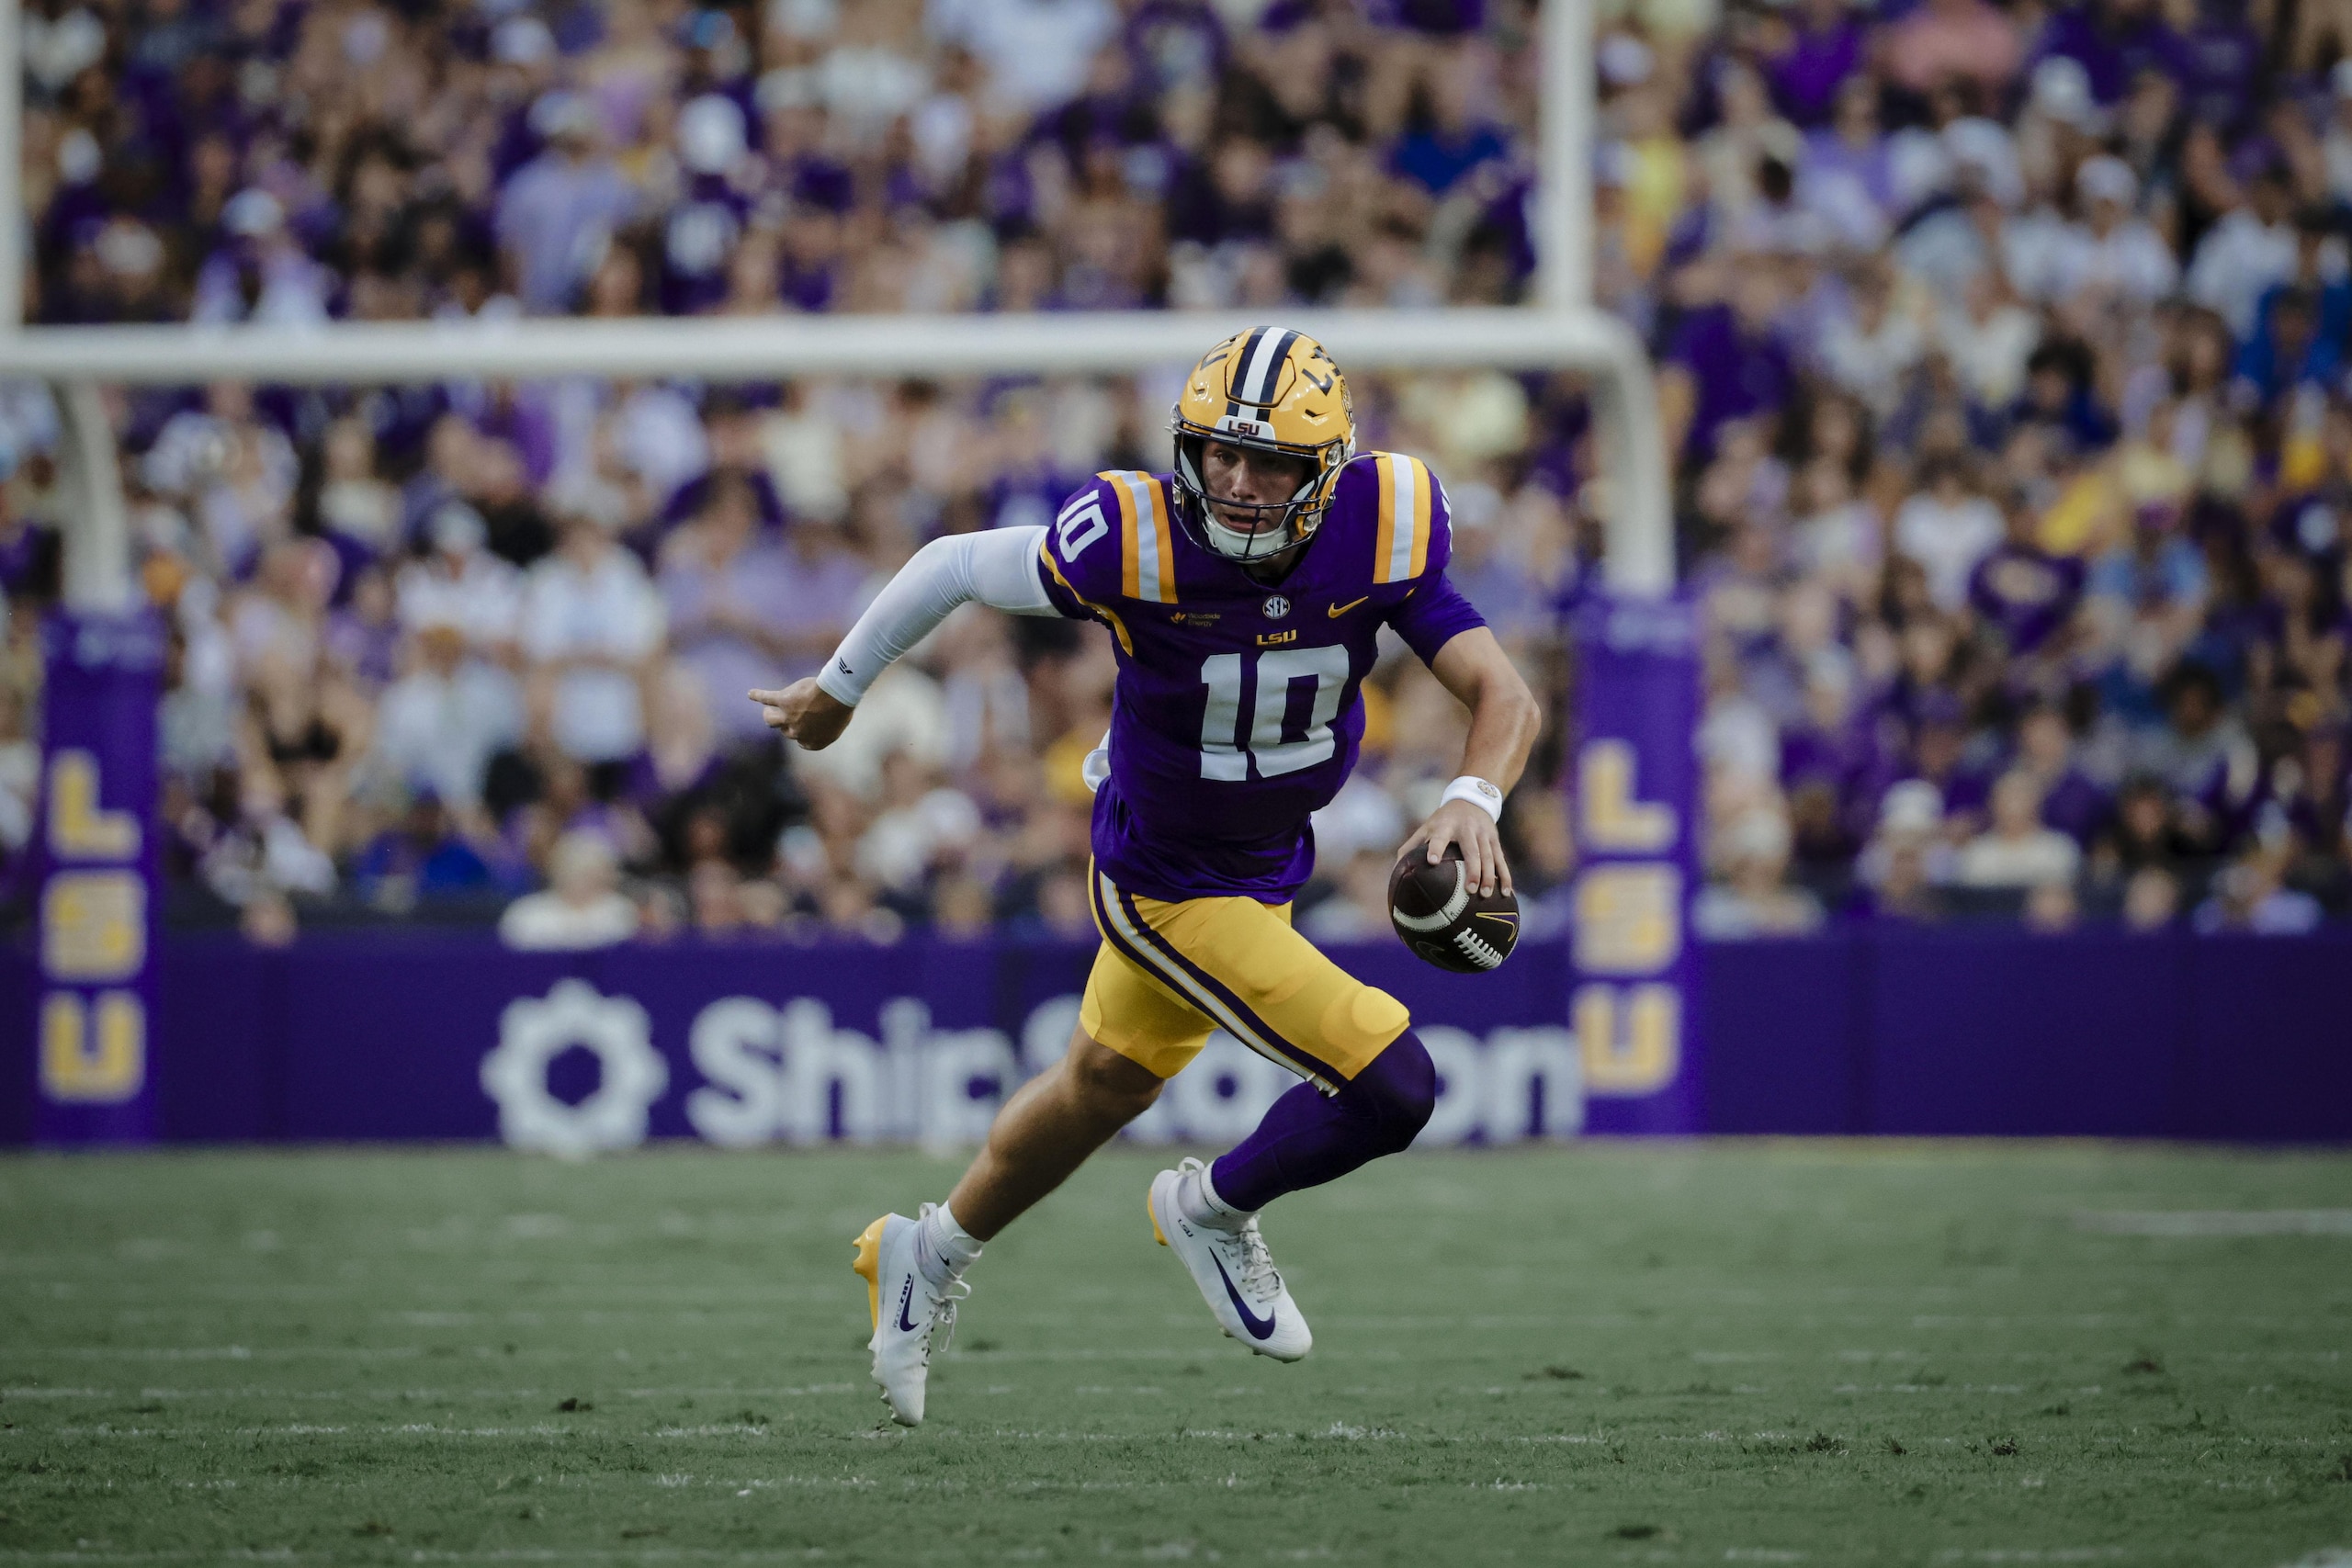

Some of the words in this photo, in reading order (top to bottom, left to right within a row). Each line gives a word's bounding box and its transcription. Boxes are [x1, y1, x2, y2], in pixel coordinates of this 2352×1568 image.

[1227, 420, 1260, 436] LSU
[1056, 490, 1109, 563] 10
[1264, 595, 1288, 618] SEC
[1256, 629, 1296, 645] LSU
[1200, 644, 1349, 781] 10
[1178, 1218, 1193, 1237] LSU
